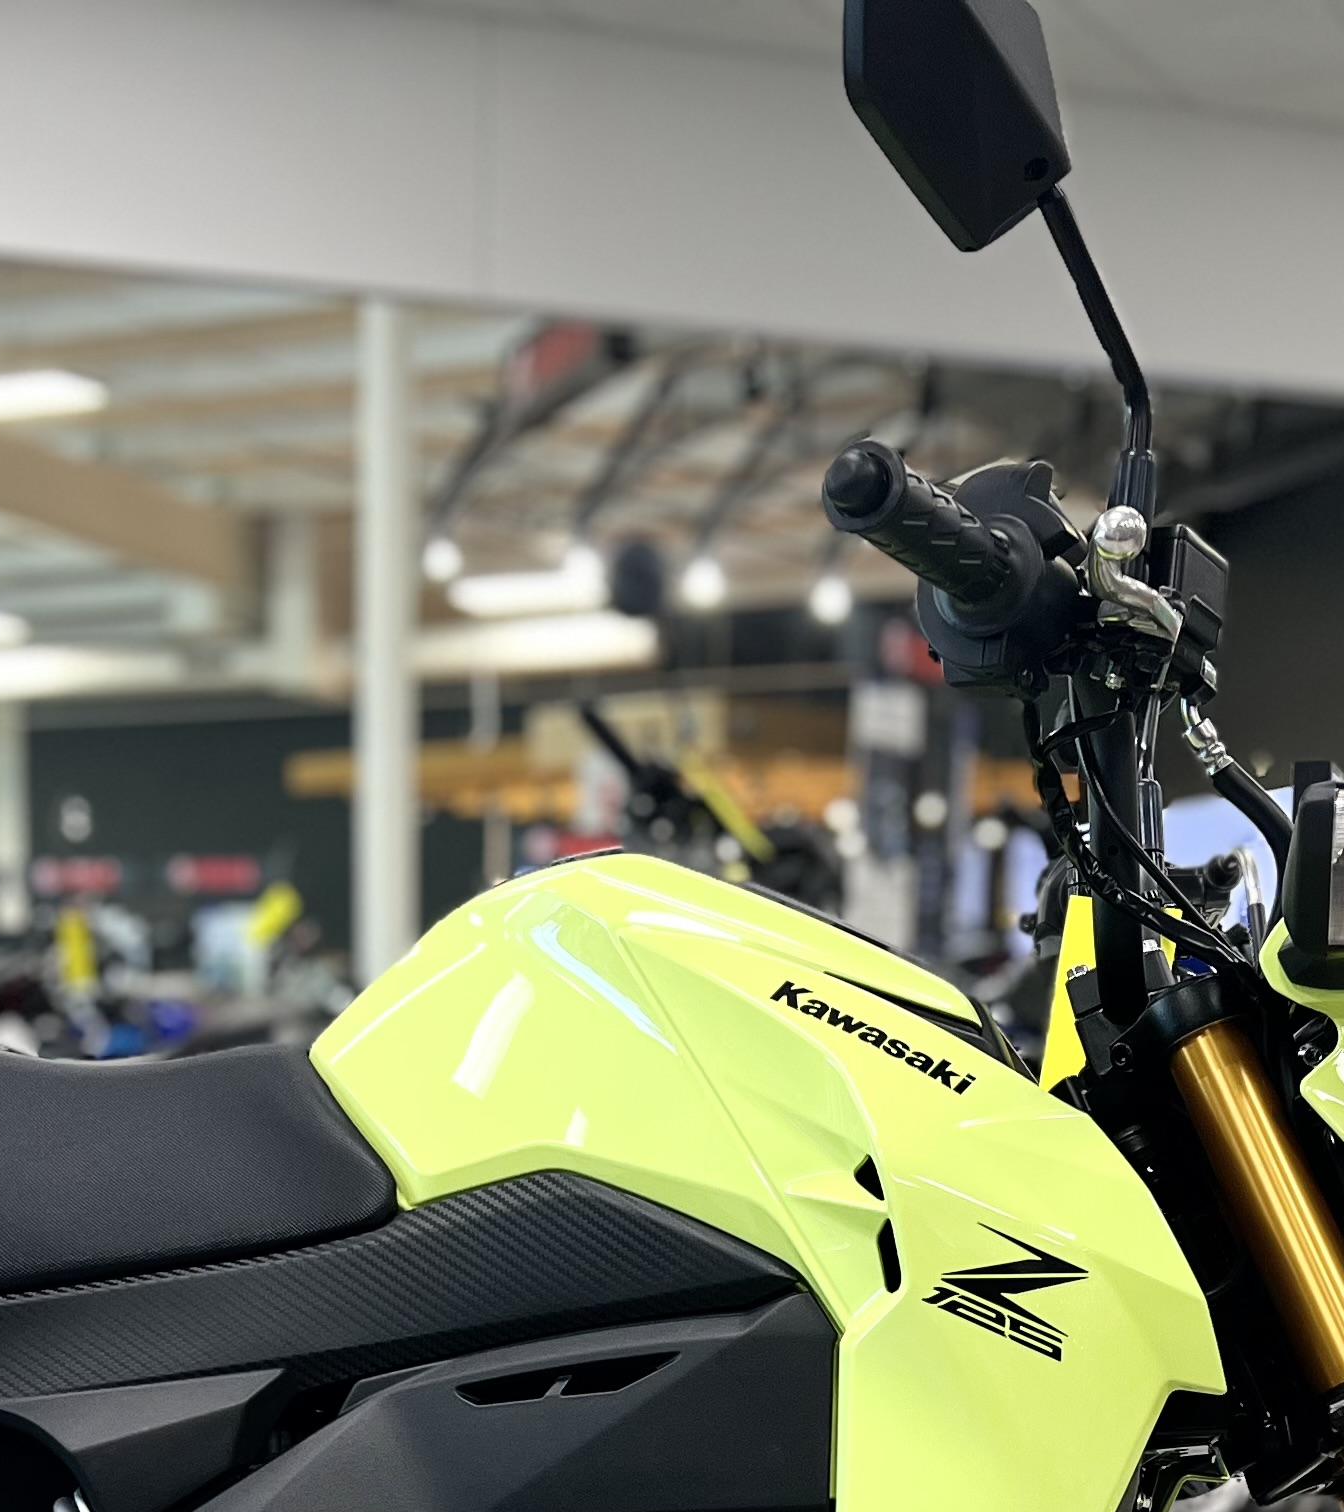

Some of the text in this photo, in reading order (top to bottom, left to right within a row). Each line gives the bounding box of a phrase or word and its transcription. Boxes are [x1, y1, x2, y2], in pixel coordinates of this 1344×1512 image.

[770, 981, 977, 1096] Kawasaki
[921, 1286, 1064, 1363] 125
[941, 1222, 1089, 1338] Z
